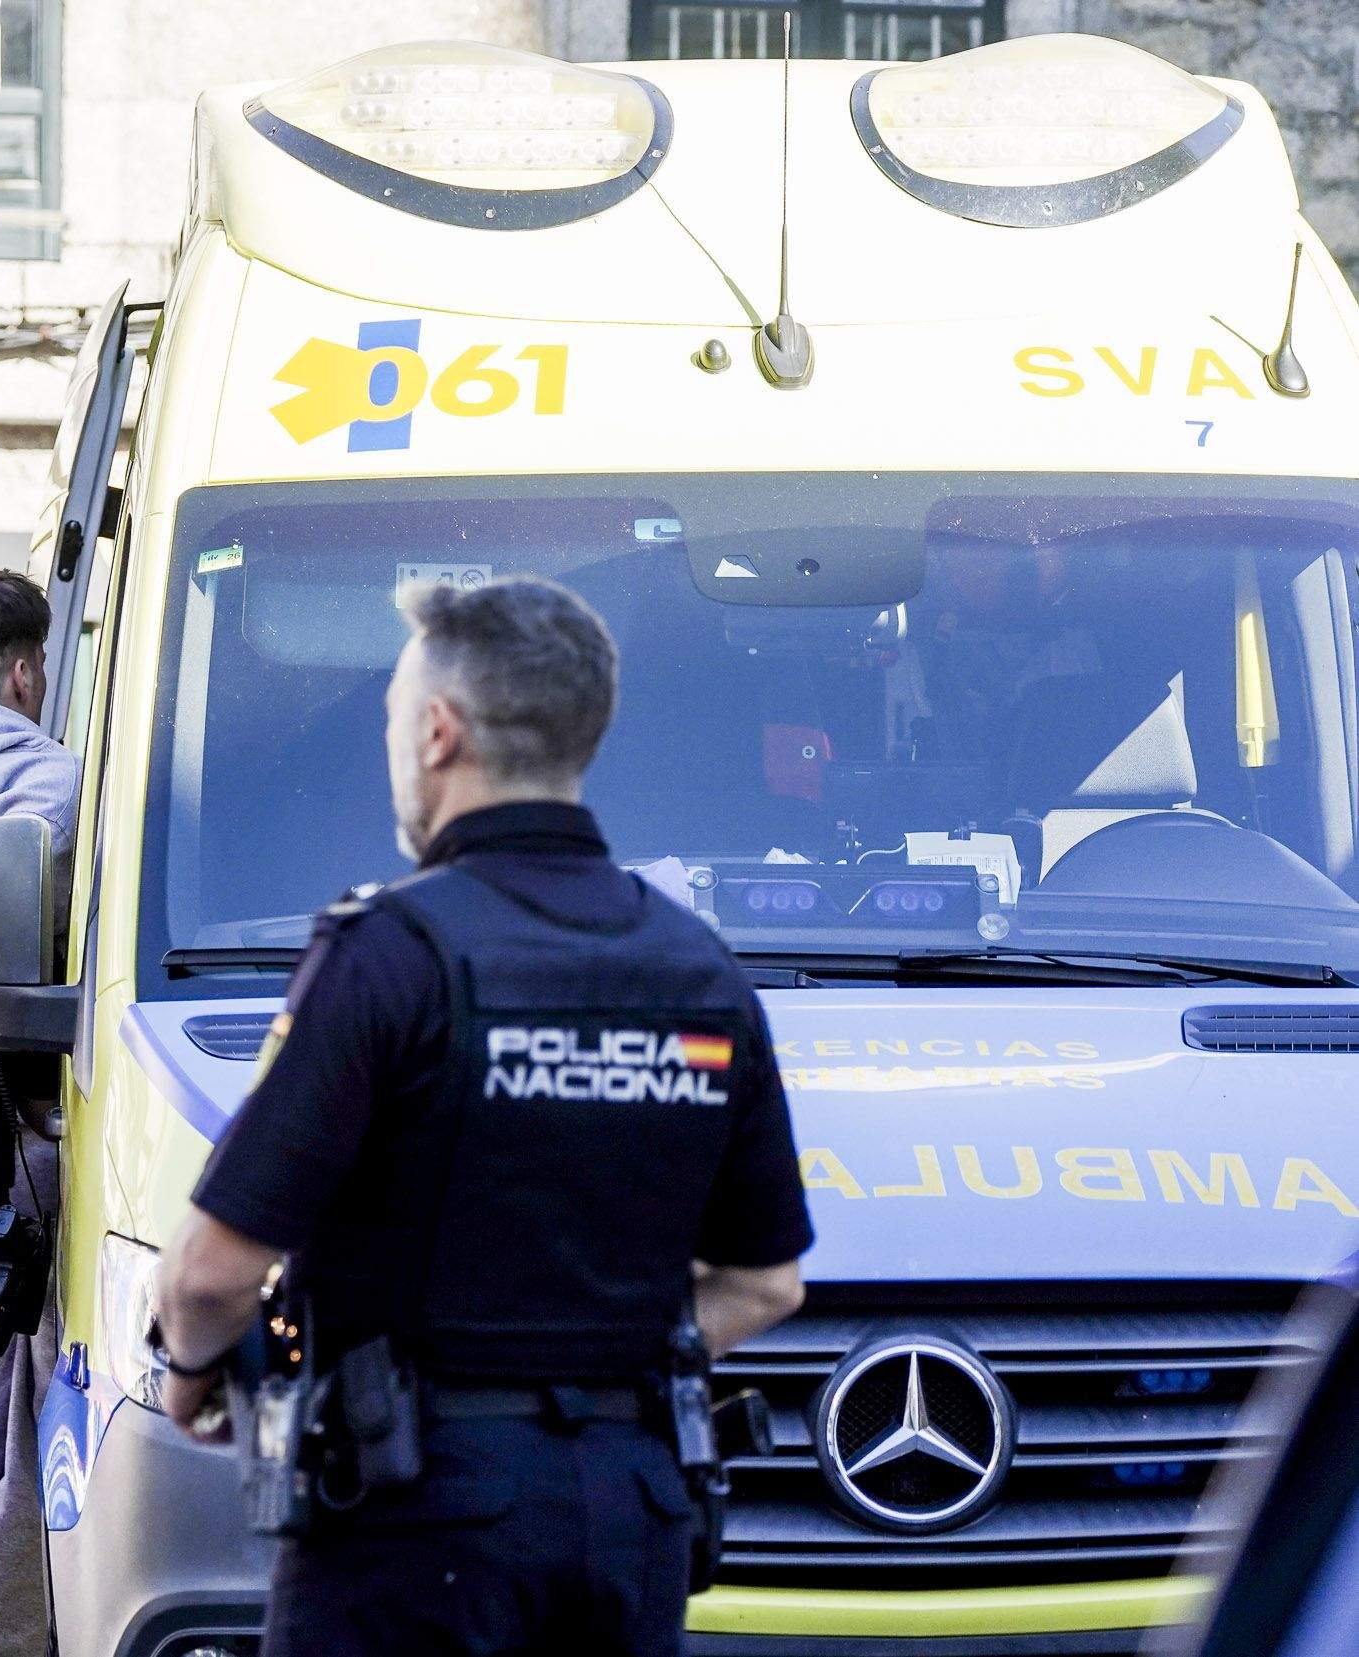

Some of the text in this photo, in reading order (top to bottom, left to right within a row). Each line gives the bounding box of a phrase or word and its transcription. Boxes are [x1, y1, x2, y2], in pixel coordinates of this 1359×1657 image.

[352, 344, 569, 422] 061
[1013, 346, 1257, 399] SVA
[1185, 420, 1214, 447] 7
[487, 1027, 688, 1069] POLICIA
[773, 1039, 1100, 1059] XENCIAS
[483, 1064, 729, 1105] NACIONAL
